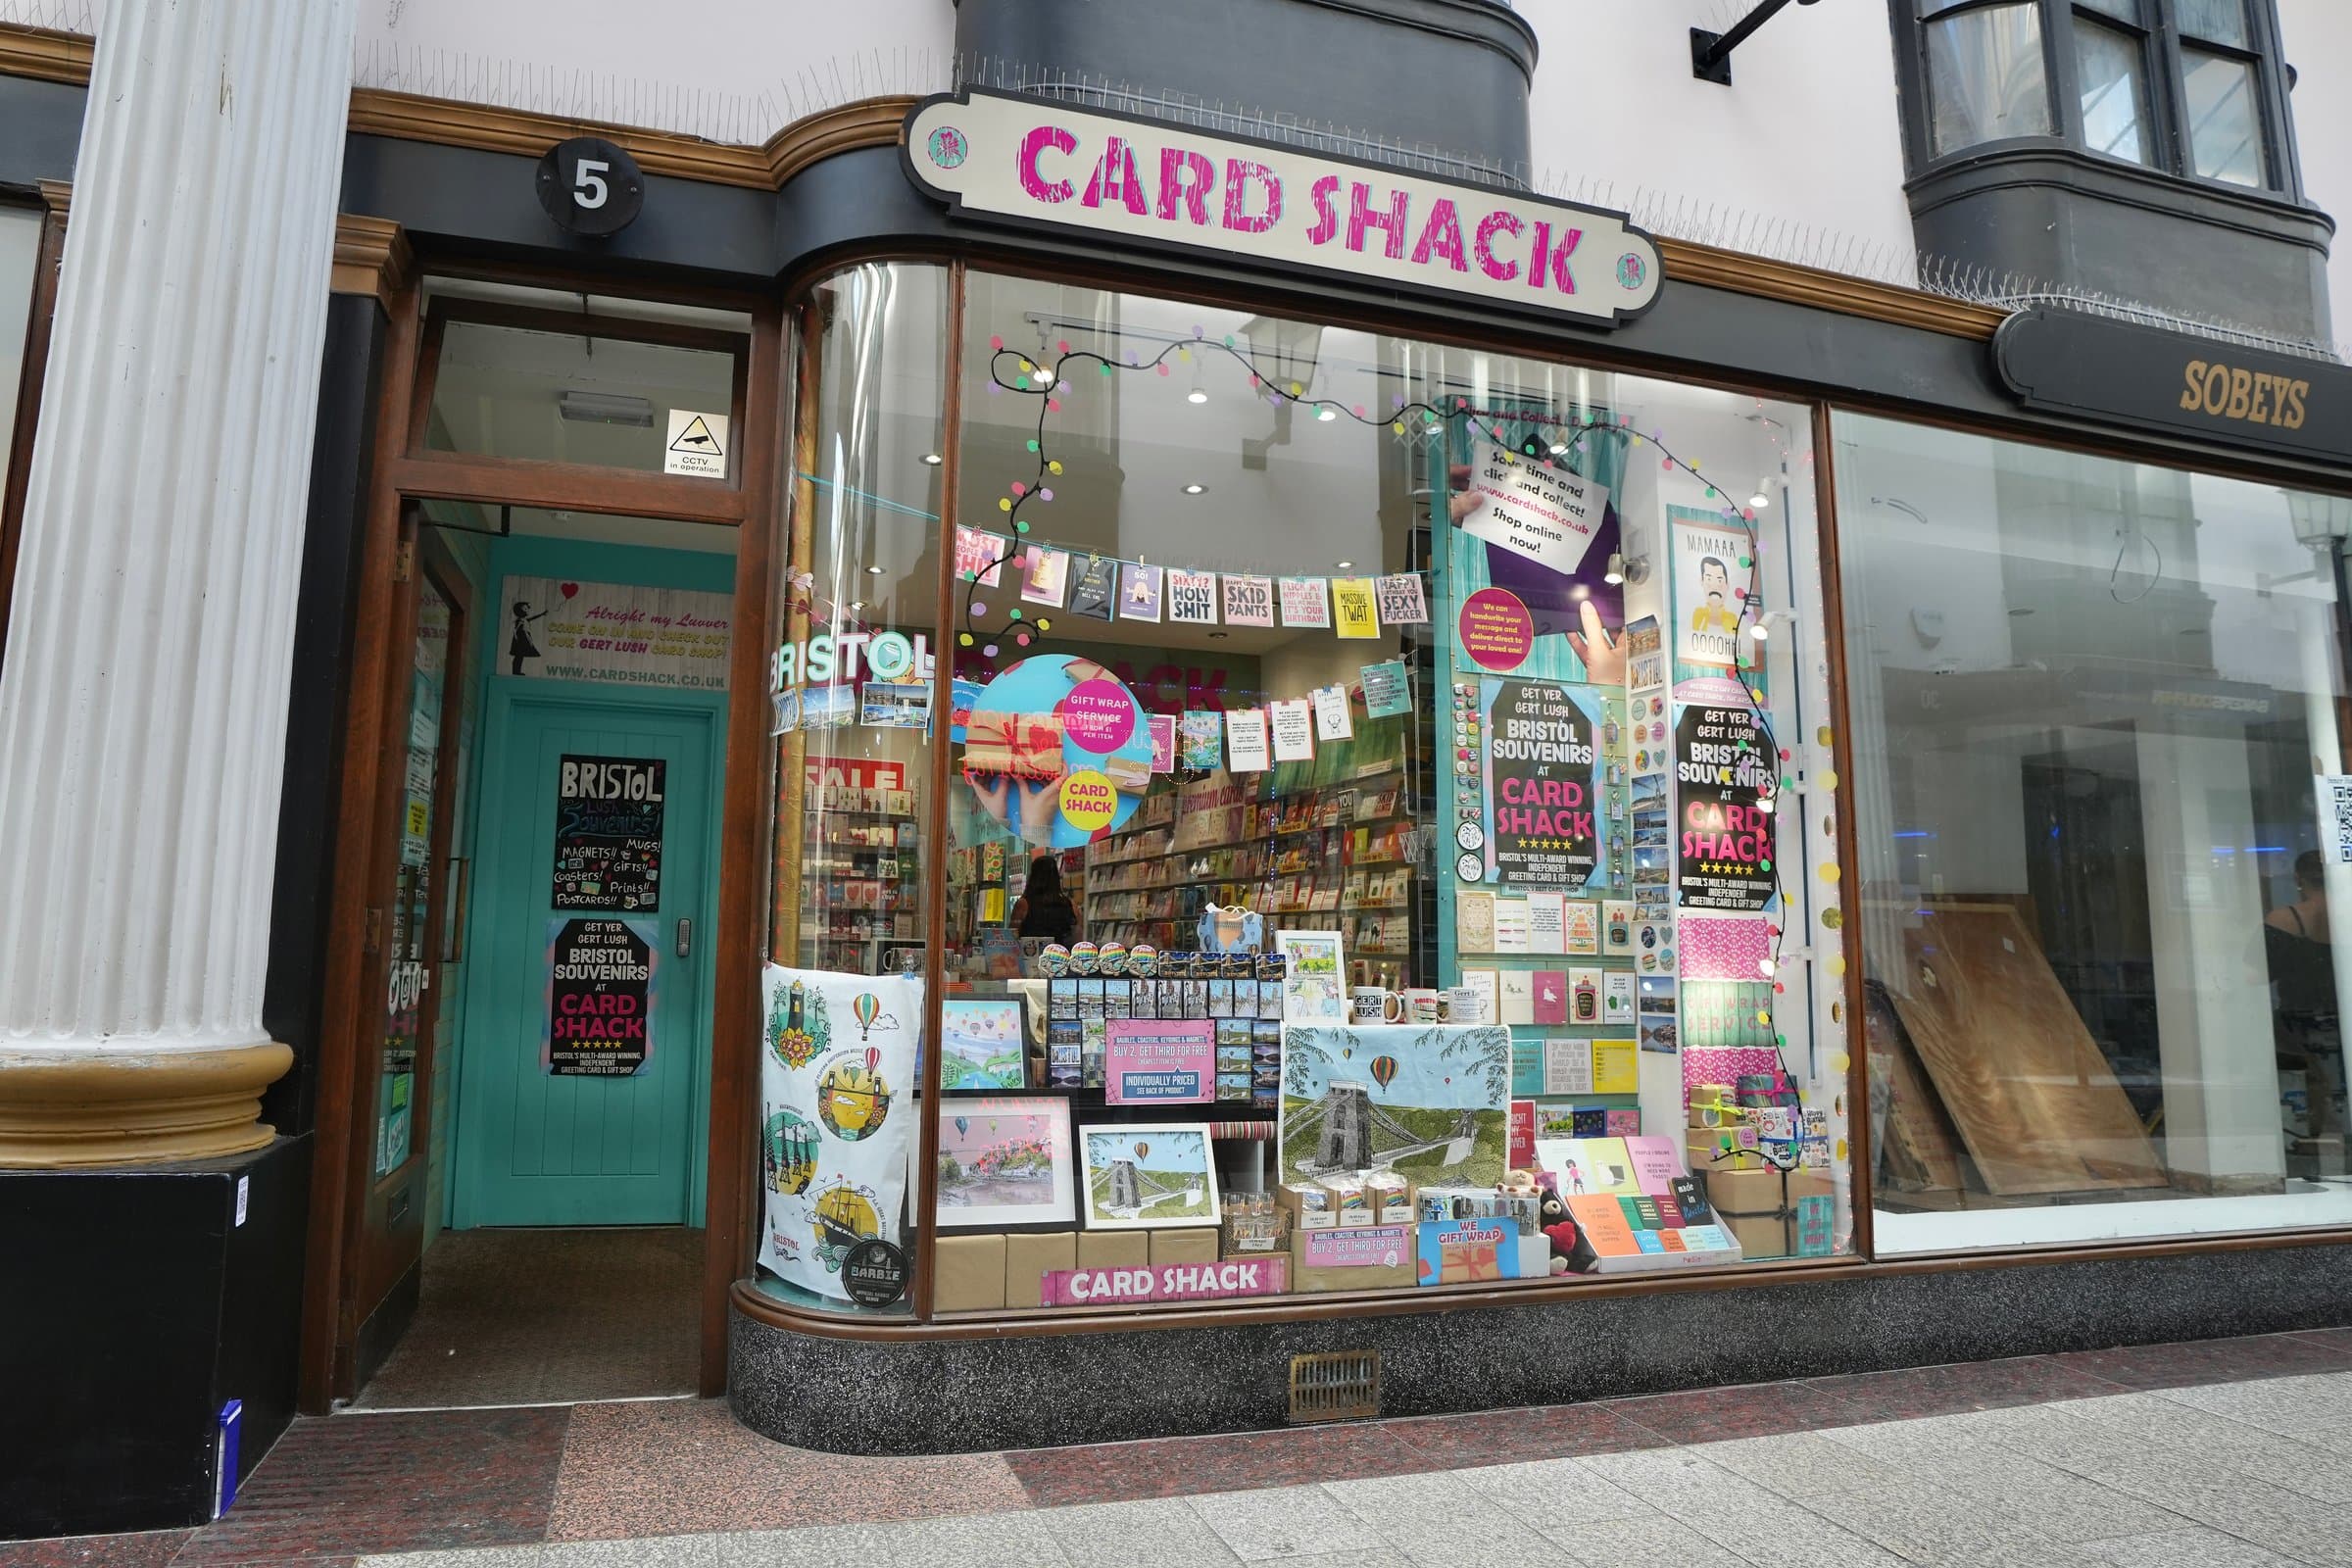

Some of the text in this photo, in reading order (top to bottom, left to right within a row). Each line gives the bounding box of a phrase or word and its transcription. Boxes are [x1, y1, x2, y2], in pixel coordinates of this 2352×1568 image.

[572, 158, 611, 210] 5
[1015, 125, 1586, 296] CARD SHACK
[2180, 360, 2310, 429] SOBEYS
[682, 456, 709, 465] CCTV
[680, 465, 719, 473] operation
[1526, 463, 1585, 499] time and
[1544, 491, 1586, 518] collect!
[1493, 507, 1563, 542] Shop online
[1509, 536, 1542, 554] now!
[1687, 534, 1737, 558] MAMAAA
[1172, 574, 1209, 588] SIXTY?
[1380, 578, 1416, 590] HAPPY
[1173, 586, 1210, 603] HOLY
[1228, 586, 1266, 605] SKID
[1340, 593, 1368, 606] MASSIVE
[1174, 602, 1211, 619] SHIT
[1227, 603, 1268, 617] PANTS
[1301, 606, 1323, 614] YOUR
[1383, 595, 1418, 611] SEXY
[586, 606, 729, 629] Alright my Luvver
[1342, 605, 1368, 622] TWAT
[1384, 610, 1422, 621] FUCKER
[579, 638, 612, 651] GERT
[614, 641, 648, 654] LUSH
[769, 630, 935, 693] BRISTOL
[546, 664, 725, 687] WWW.CARDSHACK.CO.UK
[1070, 695, 1129, 709] GIFT WRAP
[1521, 687, 1562, 702] GET YER
[1076, 710, 1122, 723] SERVICE
[1515, 702, 1569, 717] GERT LUSH
[1704, 710, 1749, 724] GET YER
[1507, 718, 1578, 743] BRISTOL
[1697, 725, 1755, 741] GERT LUSH
[1493, 739, 1592, 764] SOUVENIRS
[1537, 765, 1549, 776] AT
[1068, 783, 1109, 797] CARD
[1501, 778, 1583, 808] CARD
[1720, 789, 1733, 801] AT
[1065, 799, 1112, 813] SHACK
[1497, 807, 1593, 838] SHACK
[1687, 801, 1768, 832] CARD
[563, 847, 617, 859] MAGNETS!!
[626, 839, 662, 853] MUGS!
[1682, 830, 1775, 862] SHACK
[1498, 853, 1594, 866] BRISTOL'S MULTI-AWARD WINNING,
[1528, 862, 1566, 873] INDEPENDENT
[554, 869, 604, 883] Coasters!
[1508, 871, 1586, 884] GREETING CARD & GIFT SHOP
[1682, 876, 1773, 892] BRISTOL'S MULTI-AWARD WINNING,
[1707, 887, 1746, 898] INDEPENDENT
[1689, 896, 1764, 909] GREETING CARD & GIFT SHOP
[585, 922, 622, 932] GET YER
[578, 934, 628, 946] GERT LUSH
[569, 948, 636, 964] BRISTOL
[555, 964, 649, 981] SOUVENIRS
[595, 983, 607, 992] AT
[560, 994, 638, 1016] CARD
[1354, 996, 1382, 1005] GERT
[1355, 1006, 1382, 1018] LUSH
[554, 1016, 644, 1039] SHACK
[1113, 1046, 1128, 1057] BUY
[1139, 1046, 1152, 1057] GET
[1153, 1046, 1175, 1056] THIRD
[1177, 1046, 1190, 1056] FOR
[1192, 1045, 1207, 1055] FREE
[1126, 1074, 1195, 1086] INDIVIDUALLY PRICED
[1459, 1221, 1477, 1231] WE
[1439, 1230, 1499, 1243] GIFT WRAP
[1312, 1238, 1403, 1253] BUY GET THIRD FOR FREE
[851, 1265, 901, 1281] BARBIE
[1070, 1264, 1258, 1298] CARD SHACK
